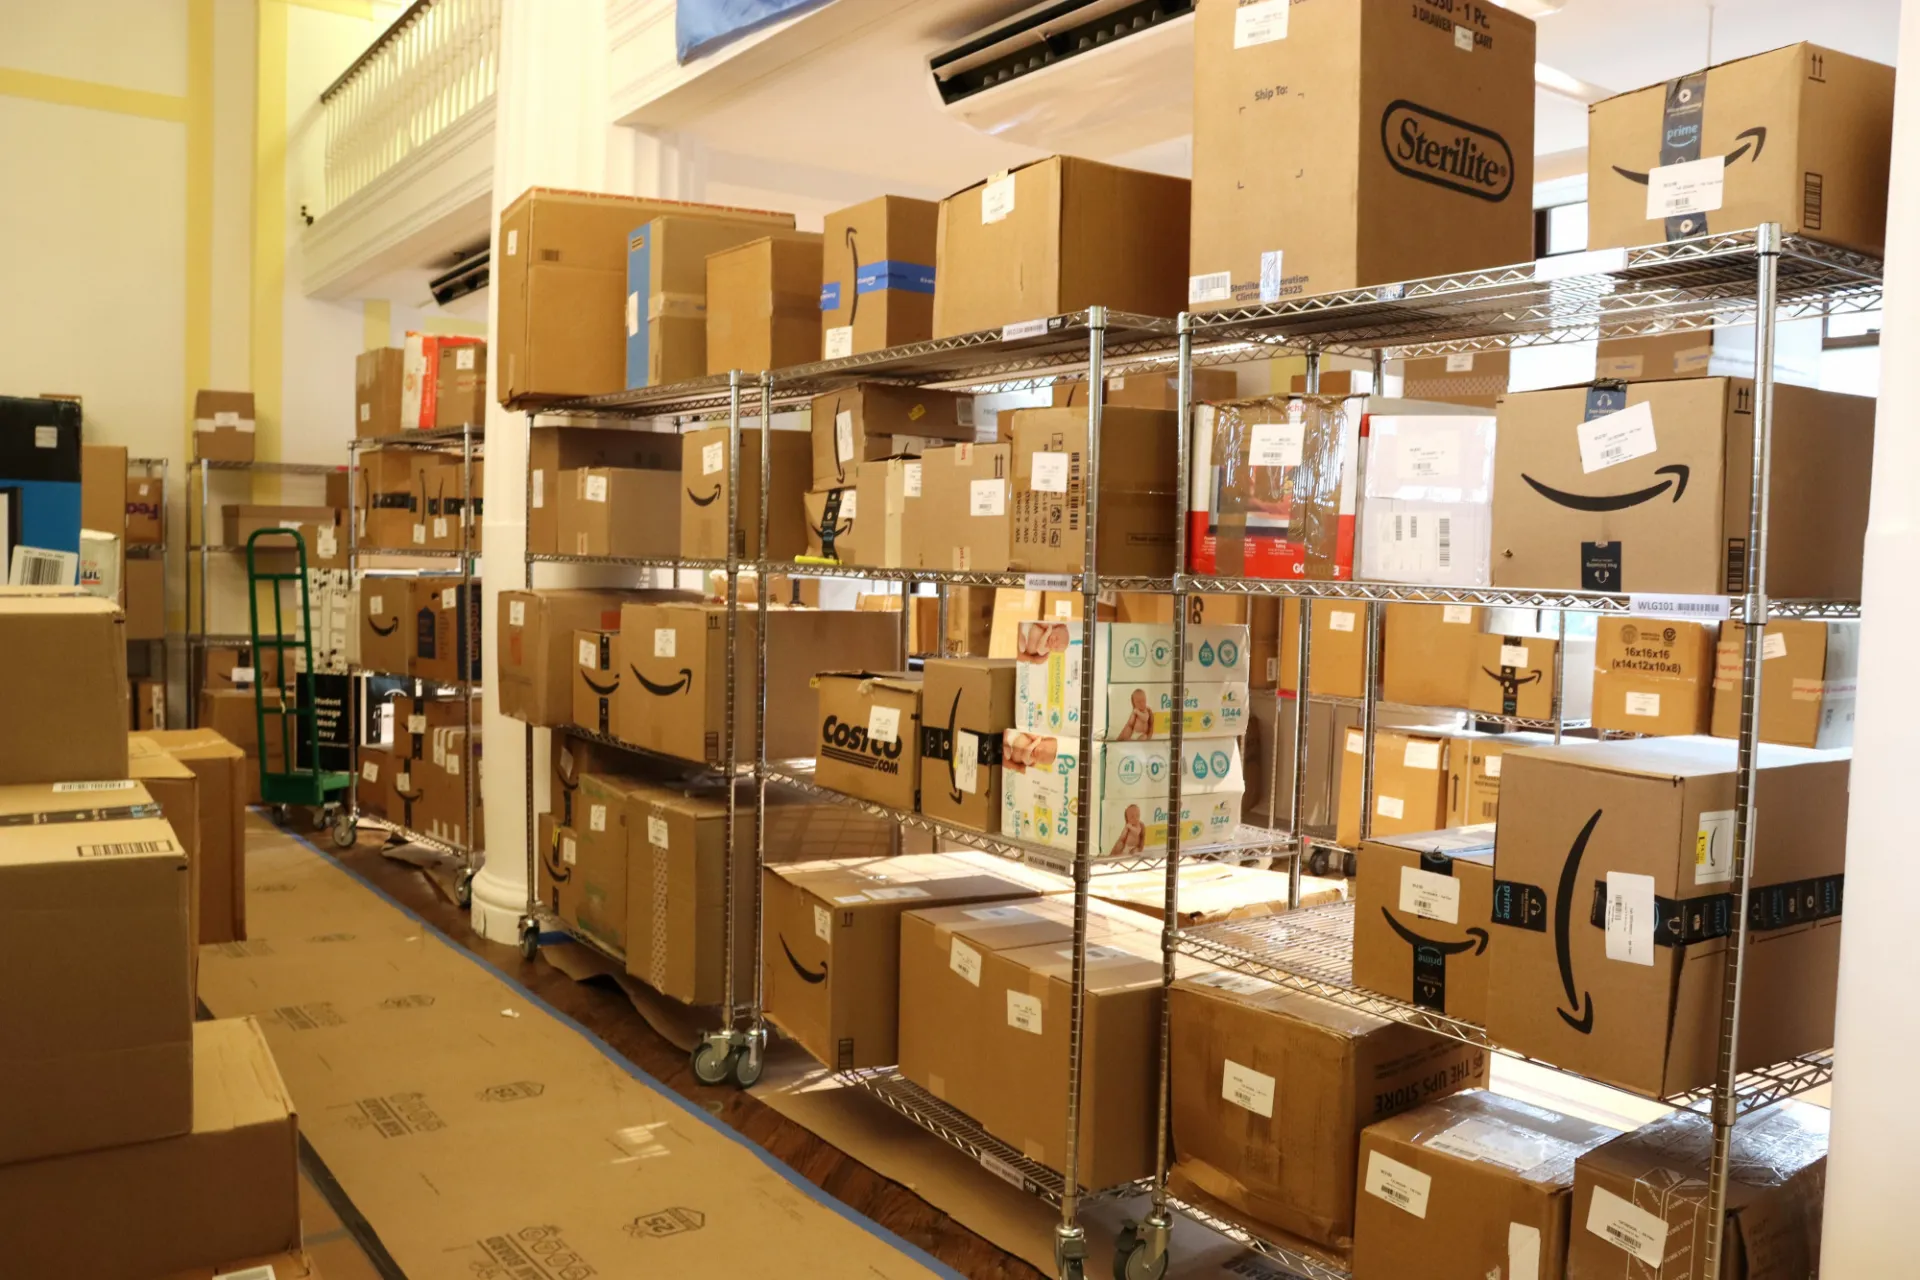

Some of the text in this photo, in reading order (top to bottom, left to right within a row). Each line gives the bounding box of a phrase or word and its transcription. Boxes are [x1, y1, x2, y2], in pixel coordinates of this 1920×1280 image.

[1254, 86, 1288, 101] Ship To:
[1666, 124, 1698, 141] prime
[1397, 117, 1500, 187] Sterilite
[1230, 280, 1260, 292] Sterilite
[1638, 600, 1674, 612] WLG101
[1625, 647, 1670, 659] 16x16x16
[1612, 659, 1681, 675] (x14x12x10x8)
[1160, 693, 1198, 710] Paers
[1222, 707, 1241, 718] 1344
[1211, 815, 1229, 825] 1344
[1503, 885, 1513, 920] prime
[1374, 1060, 1470, 1114] THE UPS STORE
